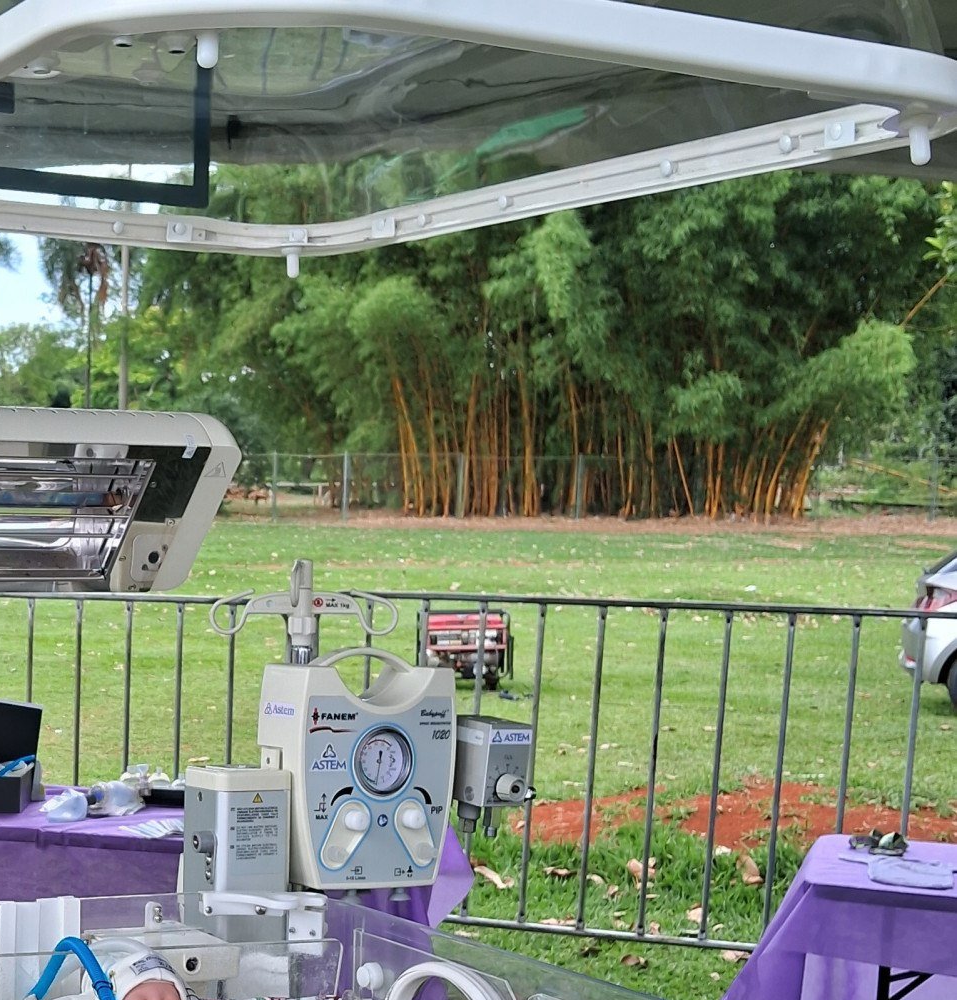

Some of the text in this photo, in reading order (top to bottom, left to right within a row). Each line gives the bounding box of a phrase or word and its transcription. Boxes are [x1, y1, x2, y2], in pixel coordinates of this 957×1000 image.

[321, 712, 358, 721] FANEM
[432, 729, 451, 740] 1020
[504, 733, 530, 742] ASTEM
[312, 760, 347, 770] ASTEM
[430, 806, 443, 815] PIP
